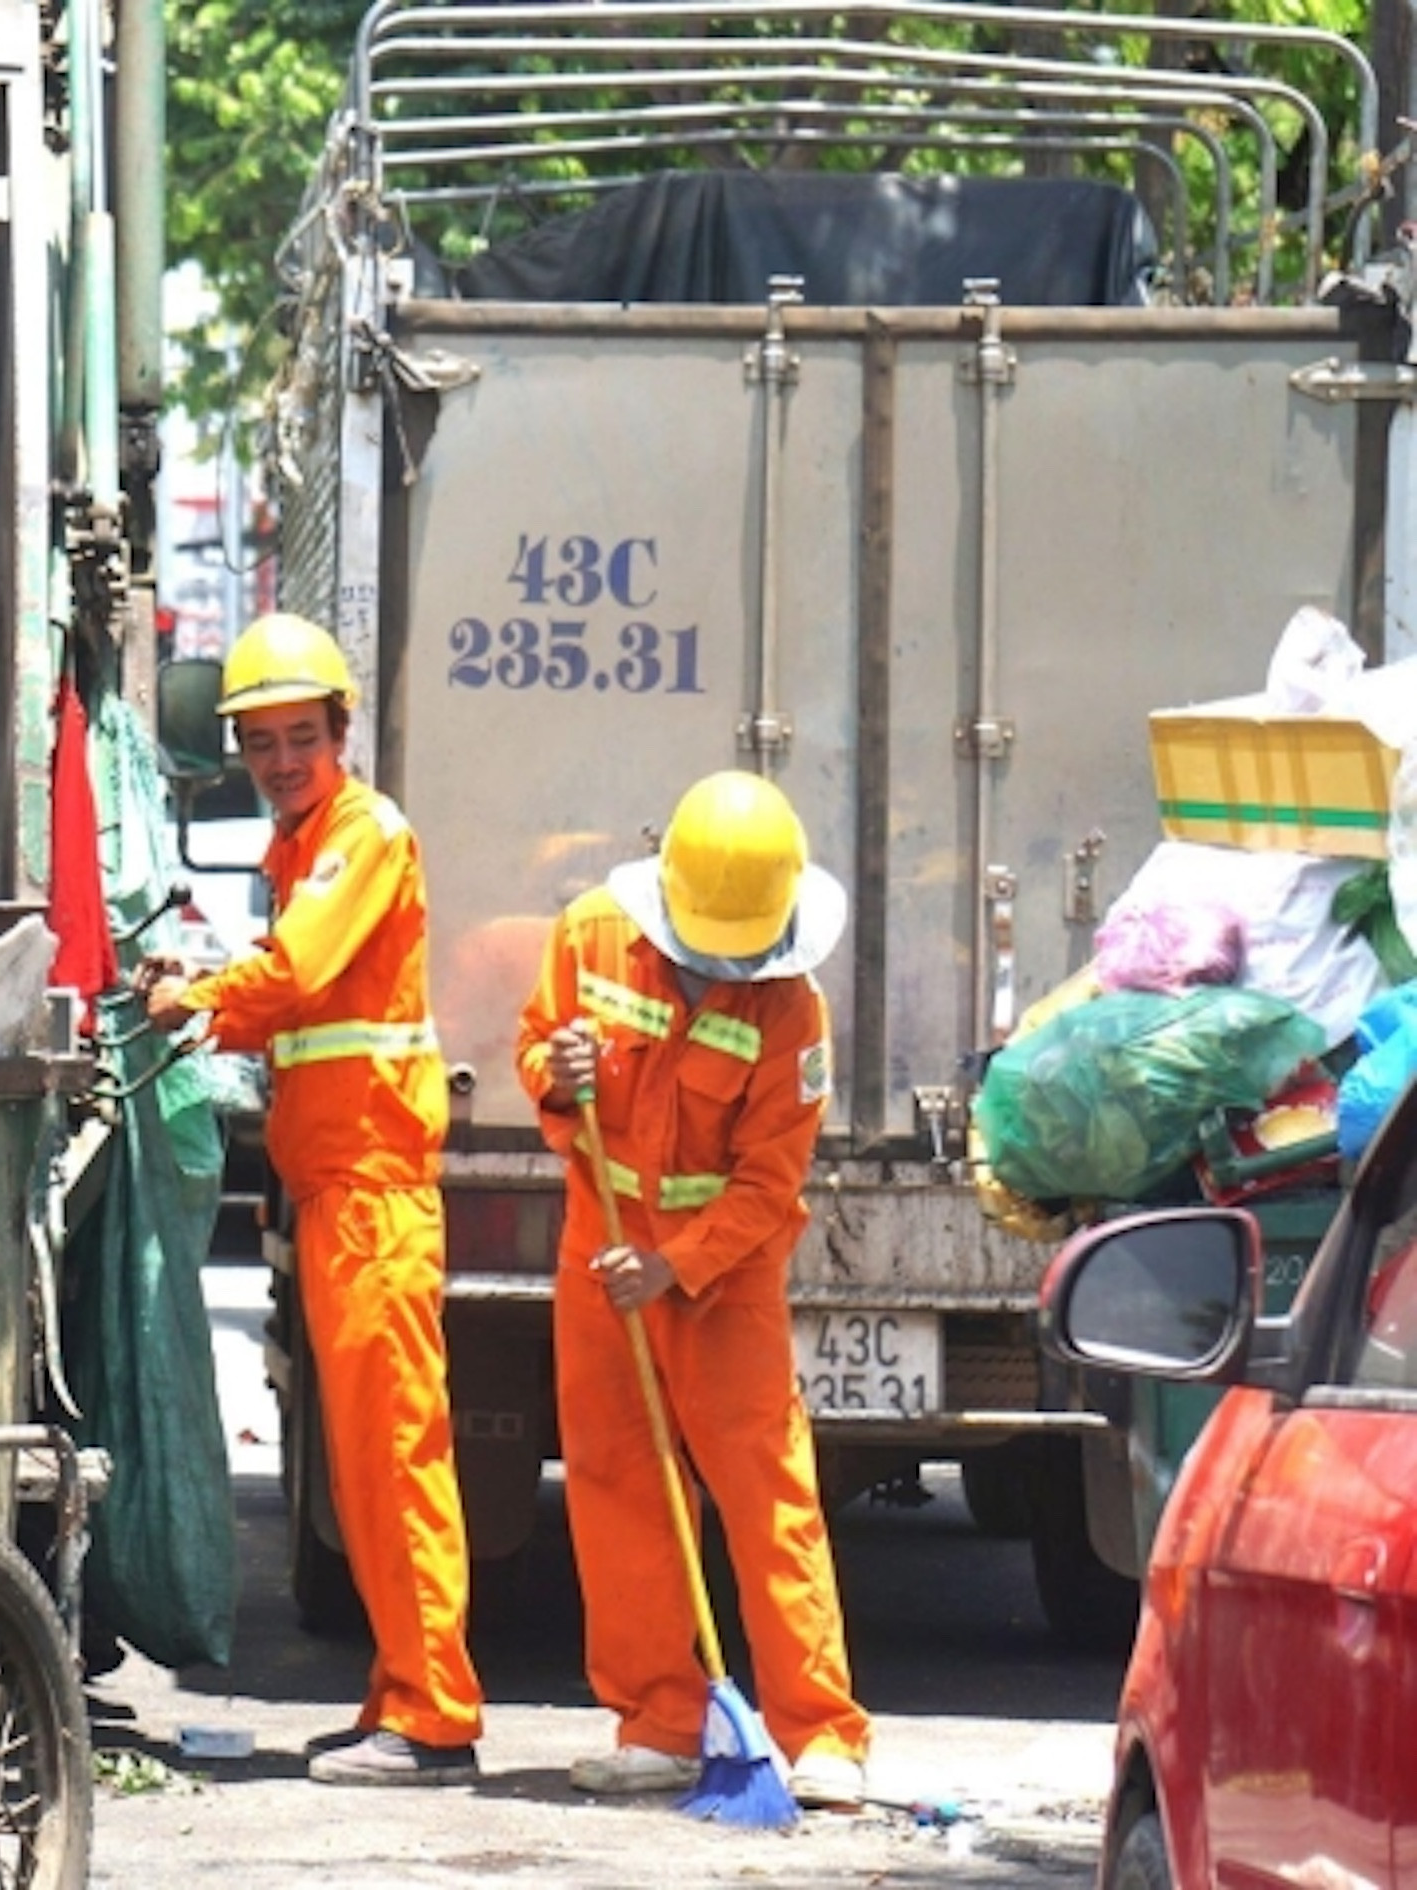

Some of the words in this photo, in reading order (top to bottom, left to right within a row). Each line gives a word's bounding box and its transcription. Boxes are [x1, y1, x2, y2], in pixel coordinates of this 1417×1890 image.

[507, 533, 658, 609] 43C
[448, 617, 706, 694] 235.31
[815, 1314, 899, 1367] 43C
